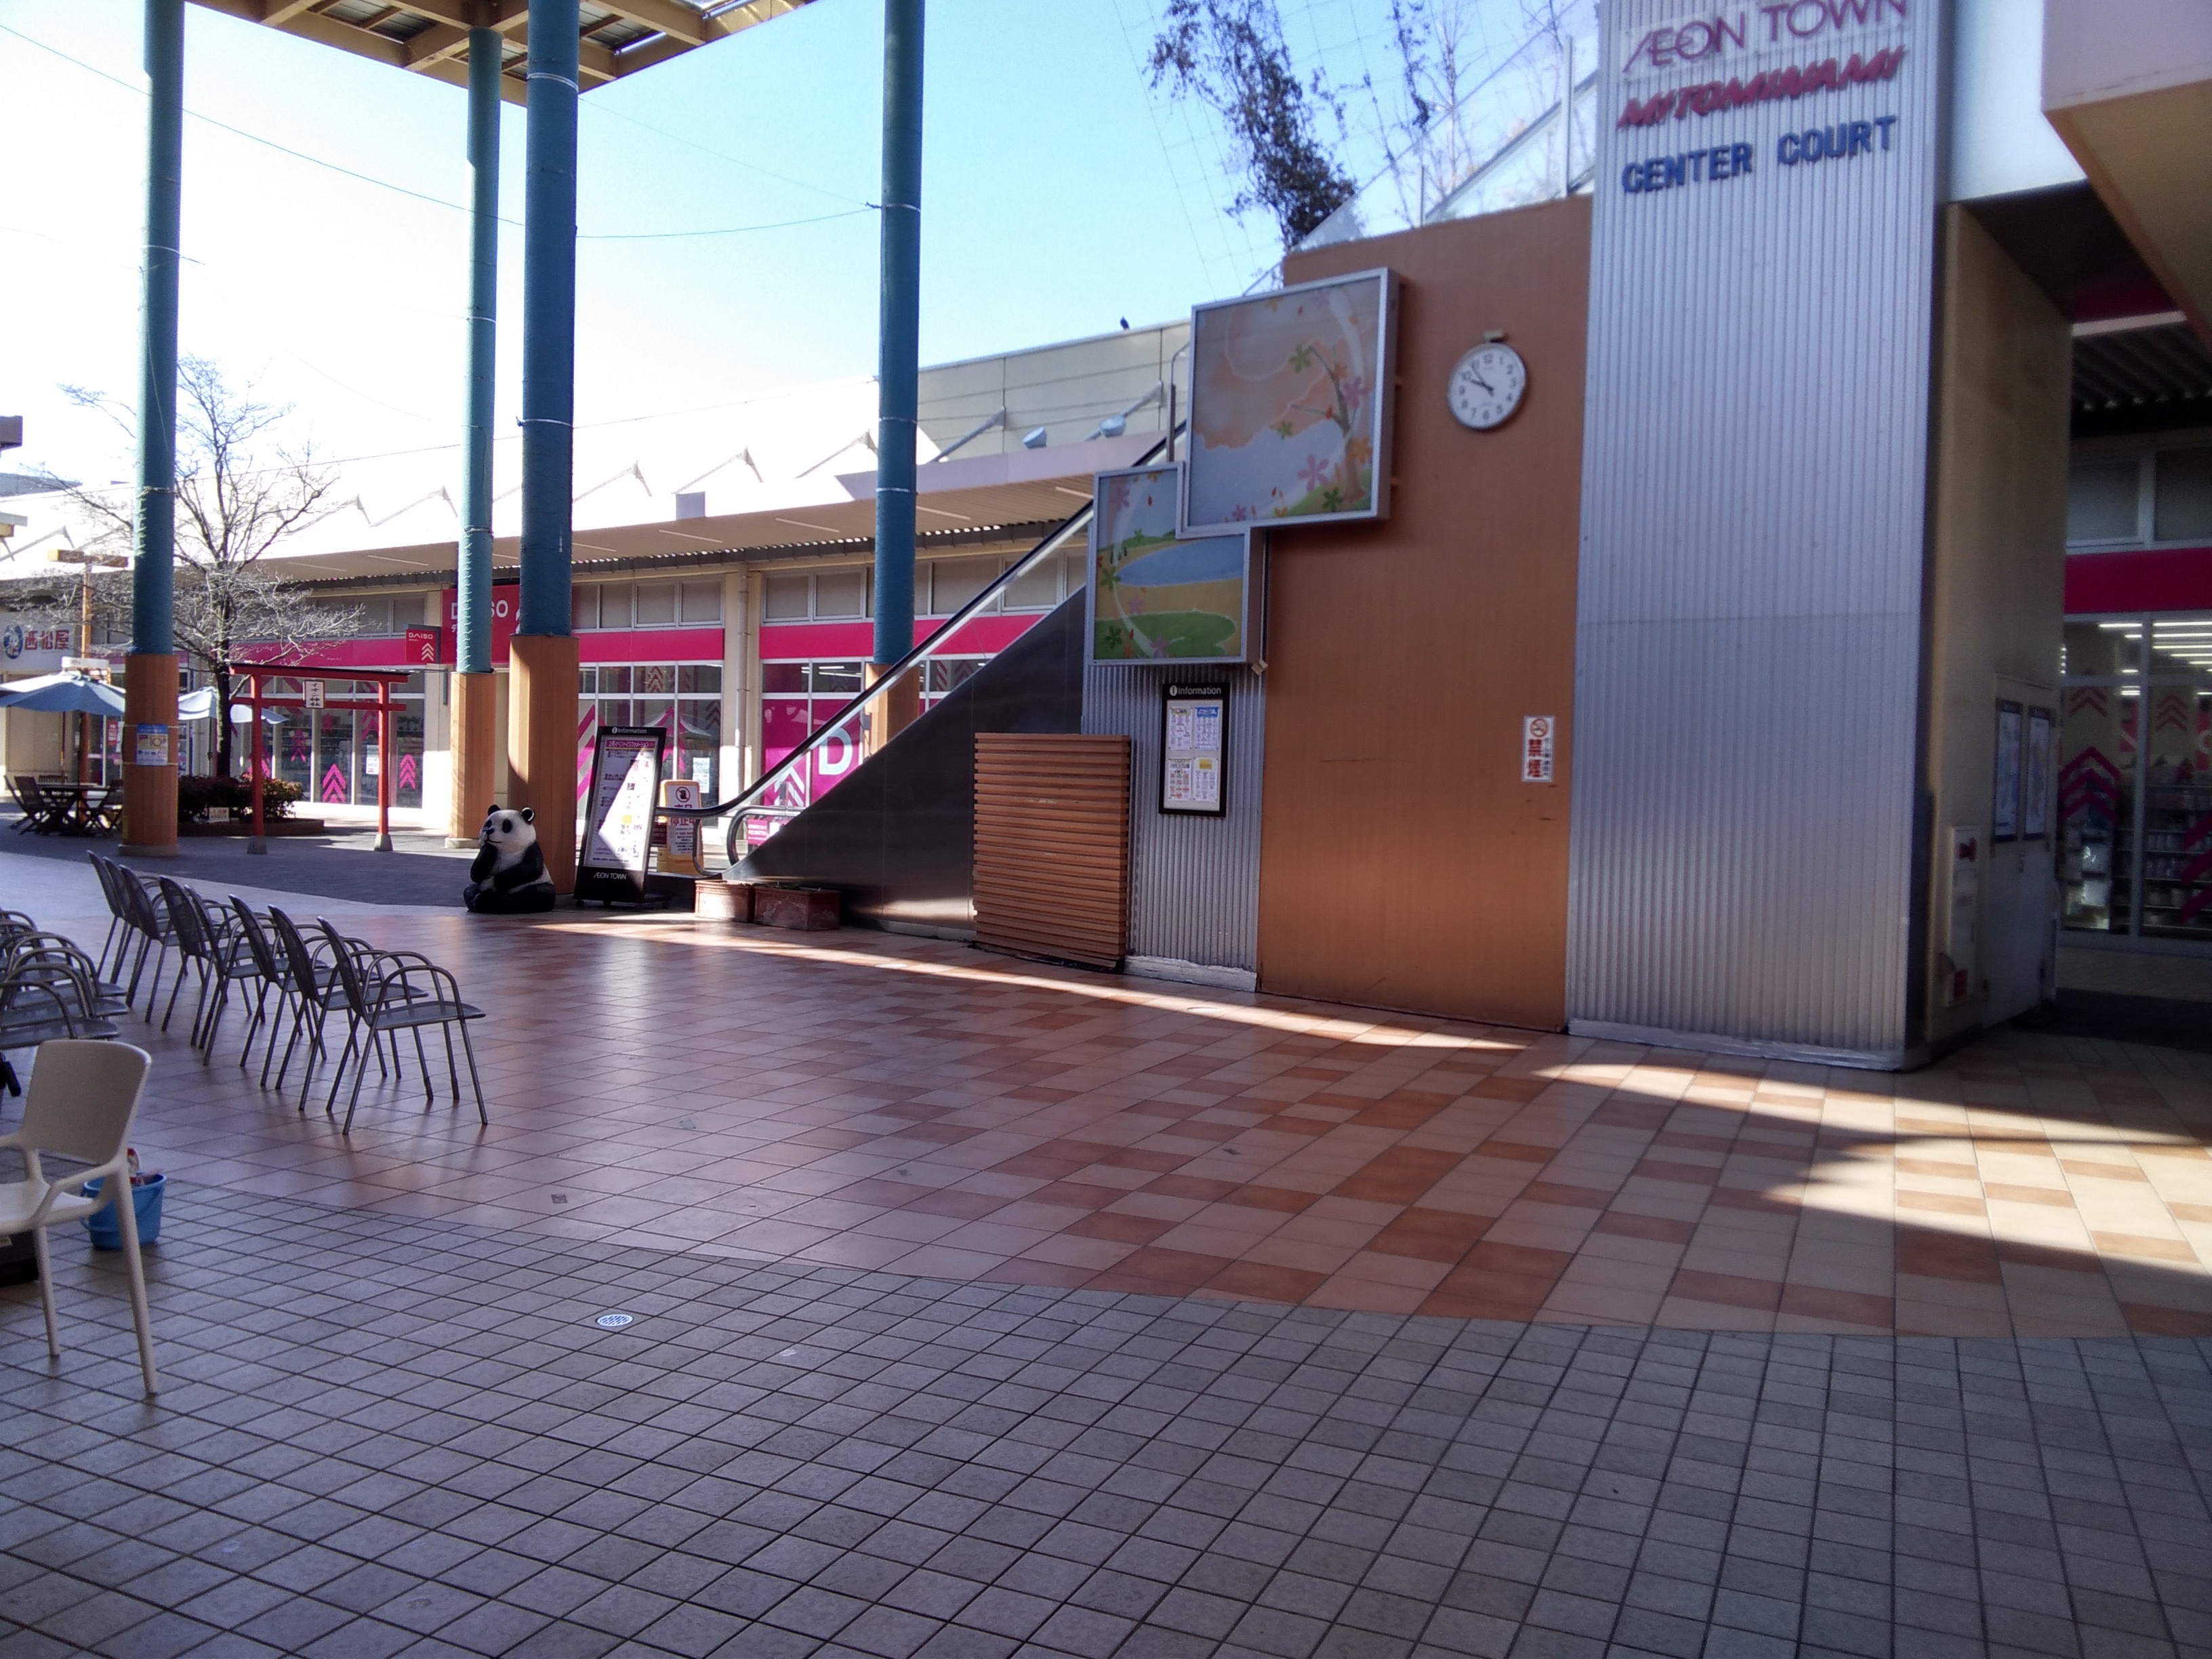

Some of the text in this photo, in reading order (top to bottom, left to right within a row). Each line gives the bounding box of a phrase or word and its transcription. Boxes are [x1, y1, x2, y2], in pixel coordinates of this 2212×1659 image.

[1763, 0, 1907, 41] TOWN
[1616, 45, 1905, 127] MITOMINAMI
[1622, 115, 1897, 193] CENTER COURT
[1178, 686, 1222, 695] Information
